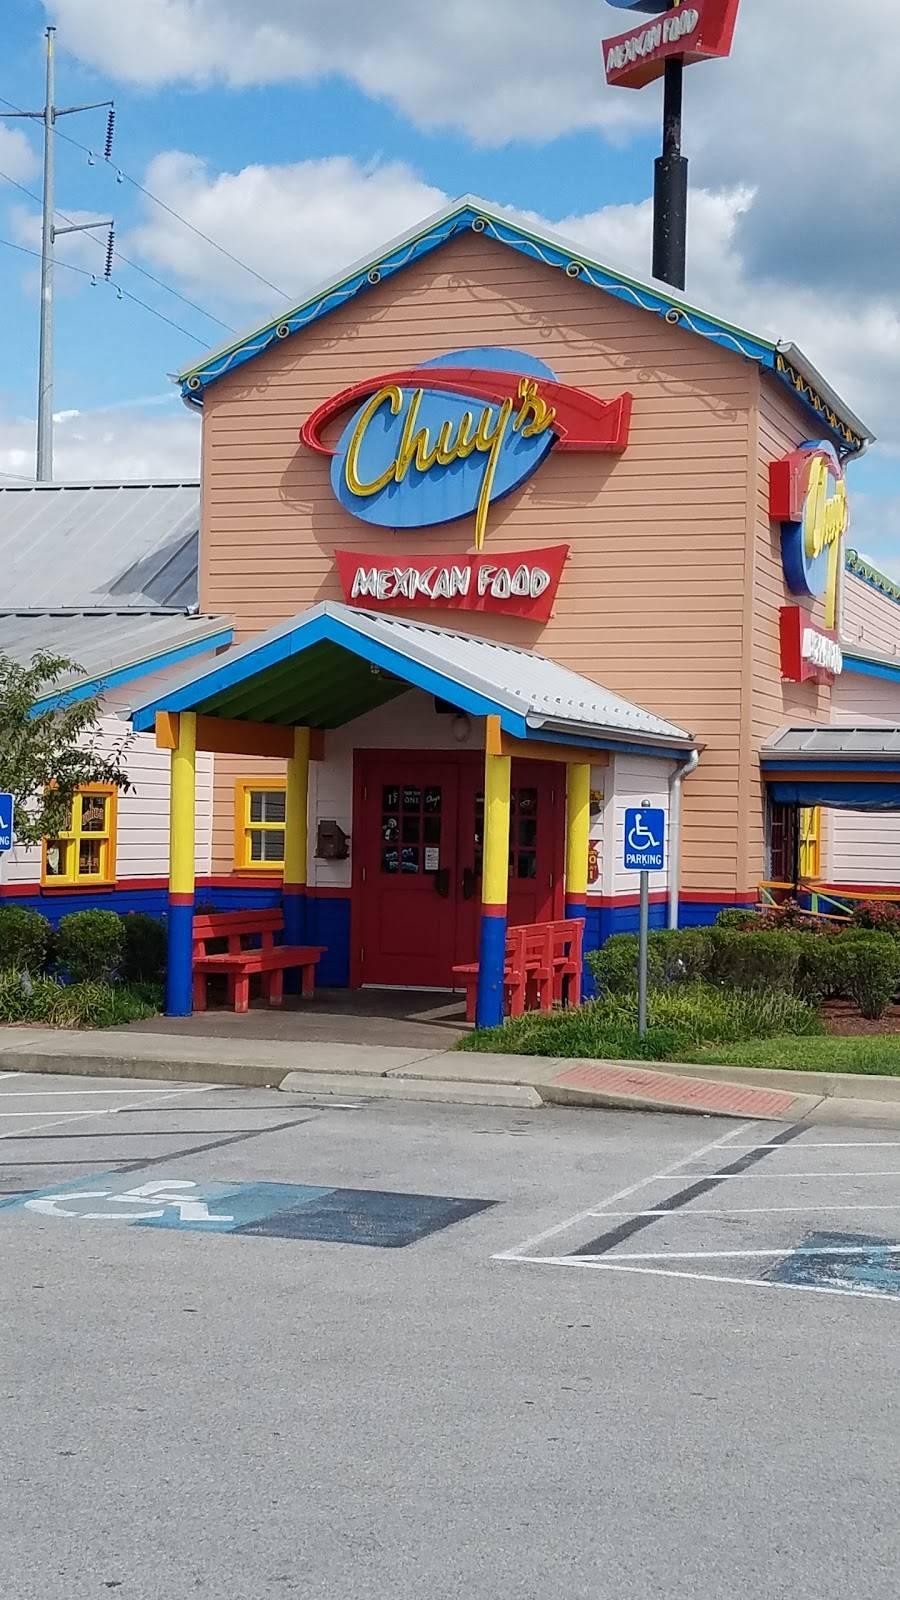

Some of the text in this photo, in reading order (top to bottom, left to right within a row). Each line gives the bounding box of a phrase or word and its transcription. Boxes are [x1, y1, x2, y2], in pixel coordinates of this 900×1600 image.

[606, 9, 699, 73] MEXICAN FOOD
[345, 377, 557, 551] Chuy's
[351, 564, 551, 600] MEXICAN FOOD
[626, 853, 662, 865] PARKING
